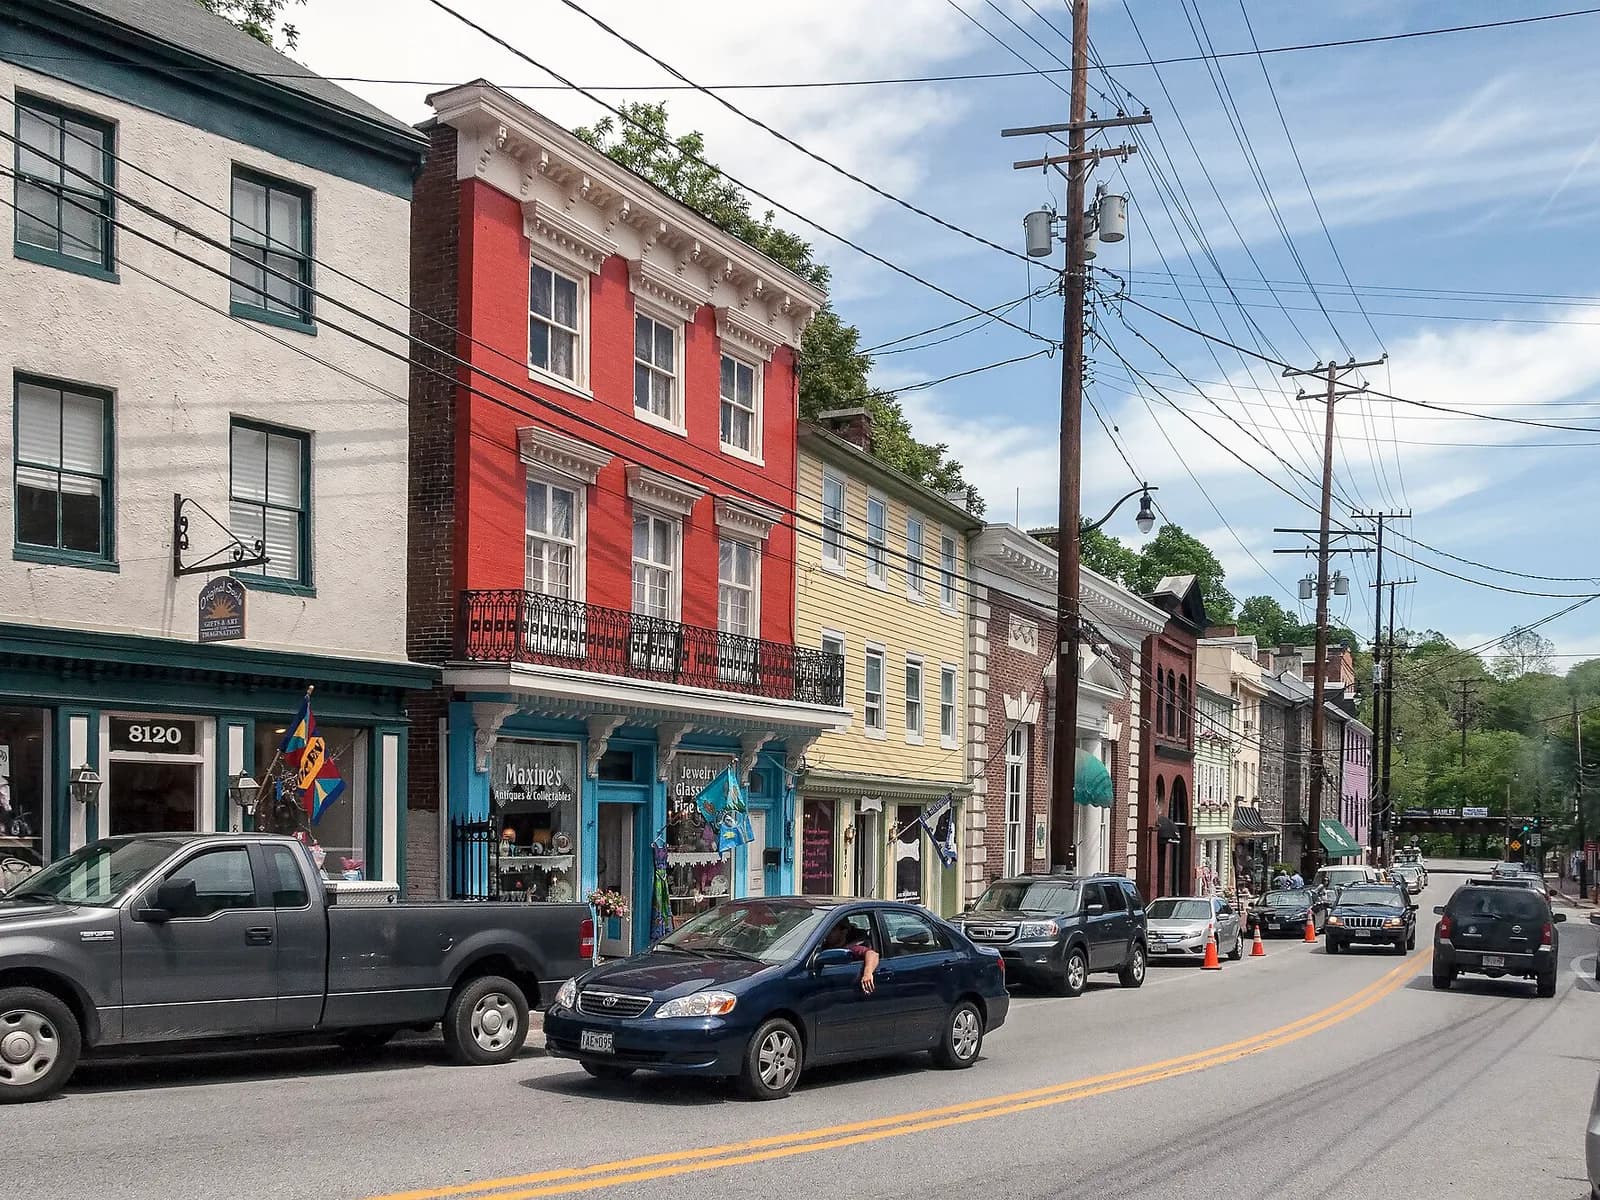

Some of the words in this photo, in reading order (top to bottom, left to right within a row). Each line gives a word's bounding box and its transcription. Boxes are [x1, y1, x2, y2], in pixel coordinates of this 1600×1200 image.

[200, 580, 226, 610] Original
[128, 725, 182, 744] 8120
[505, 762, 562, 787] Maxine's
[681, 766, 717, 781] Jewelry
[494, 790, 525, 802] Antiques
[526, 790, 533, 801] &
[533, 790, 572, 802] Collectables
[1433, 808, 1457, 816] HAMLET
